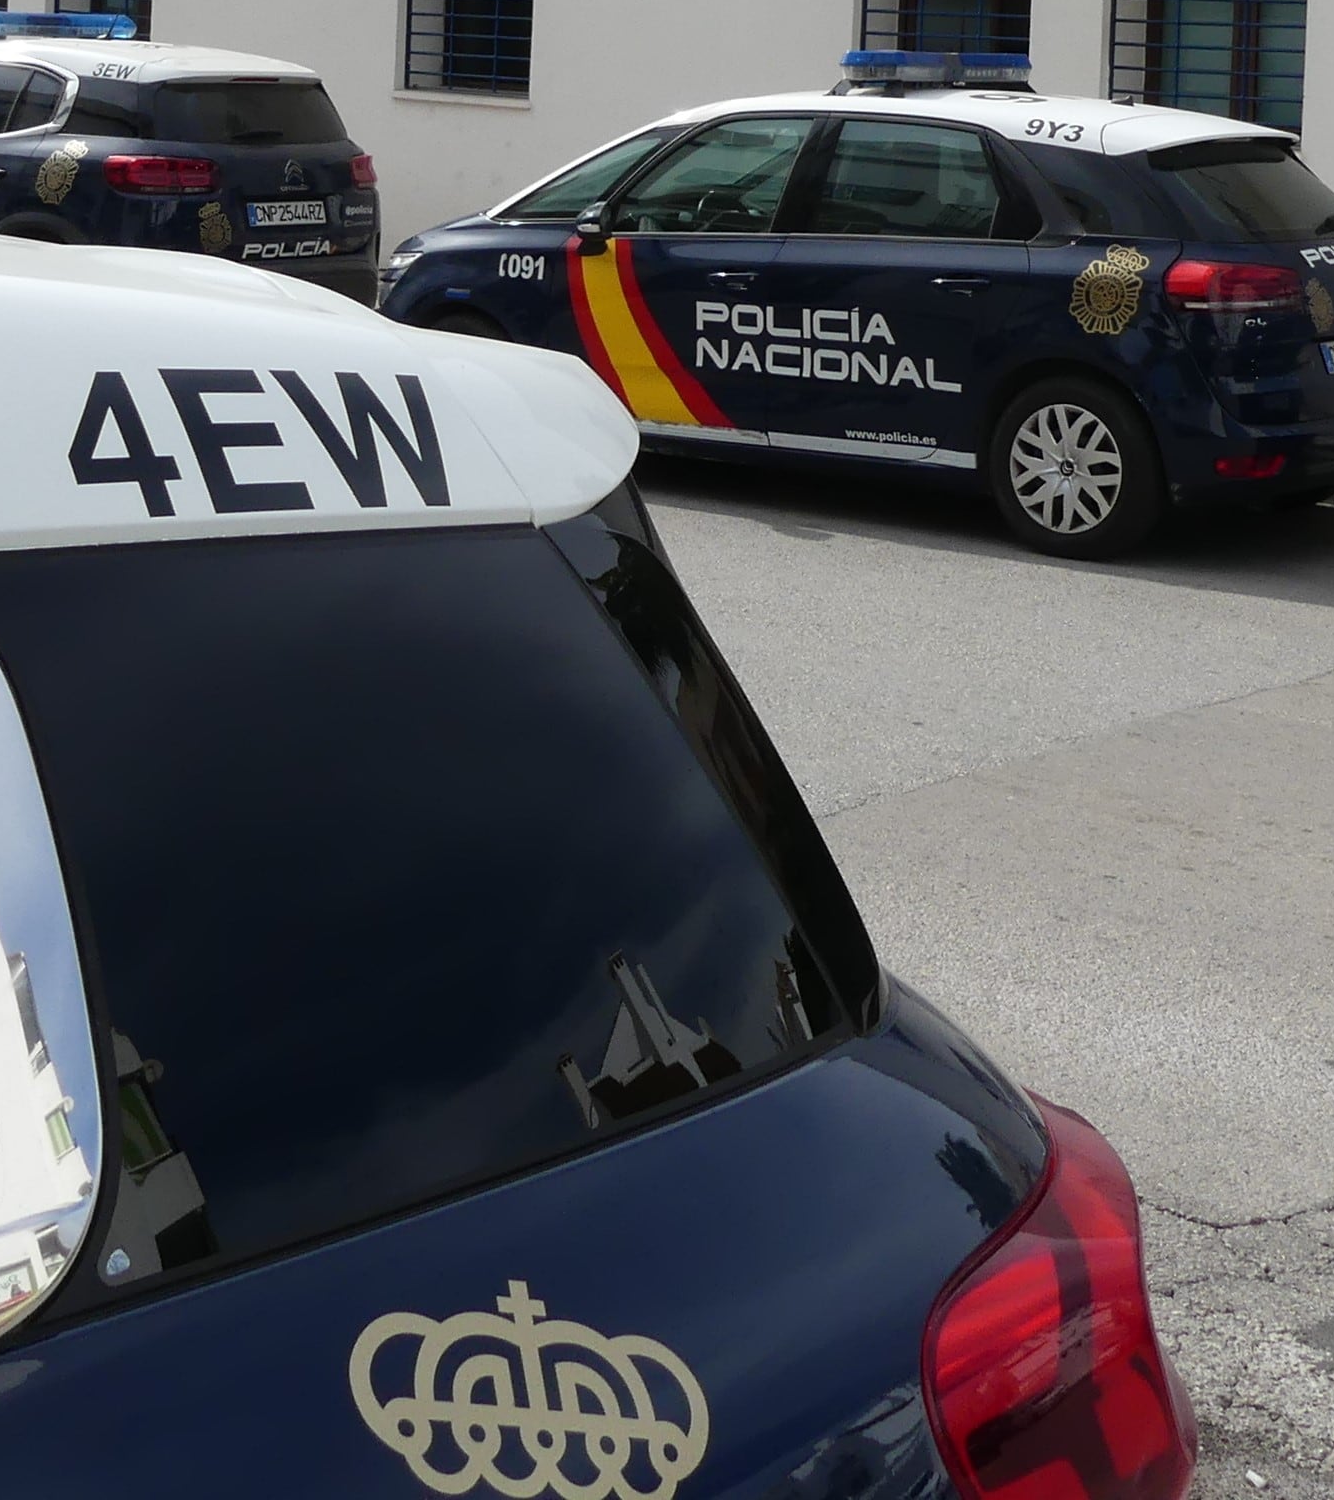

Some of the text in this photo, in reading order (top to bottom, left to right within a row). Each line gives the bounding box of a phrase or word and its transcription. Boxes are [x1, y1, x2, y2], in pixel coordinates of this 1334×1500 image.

[92, 62, 137, 79] 3EW
[1024, 118, 1085, 142] 9Y3
[241, 237, 331, 259] POLICÍA
[508, 254, 545, 280] 091
[696, 301, 896, 345] POLICÍA
[695, 337, 962, 393] NACIONAL
[68, 368, 452, 518] 4EW
[845, 428, 937, 446] www.policia.es
